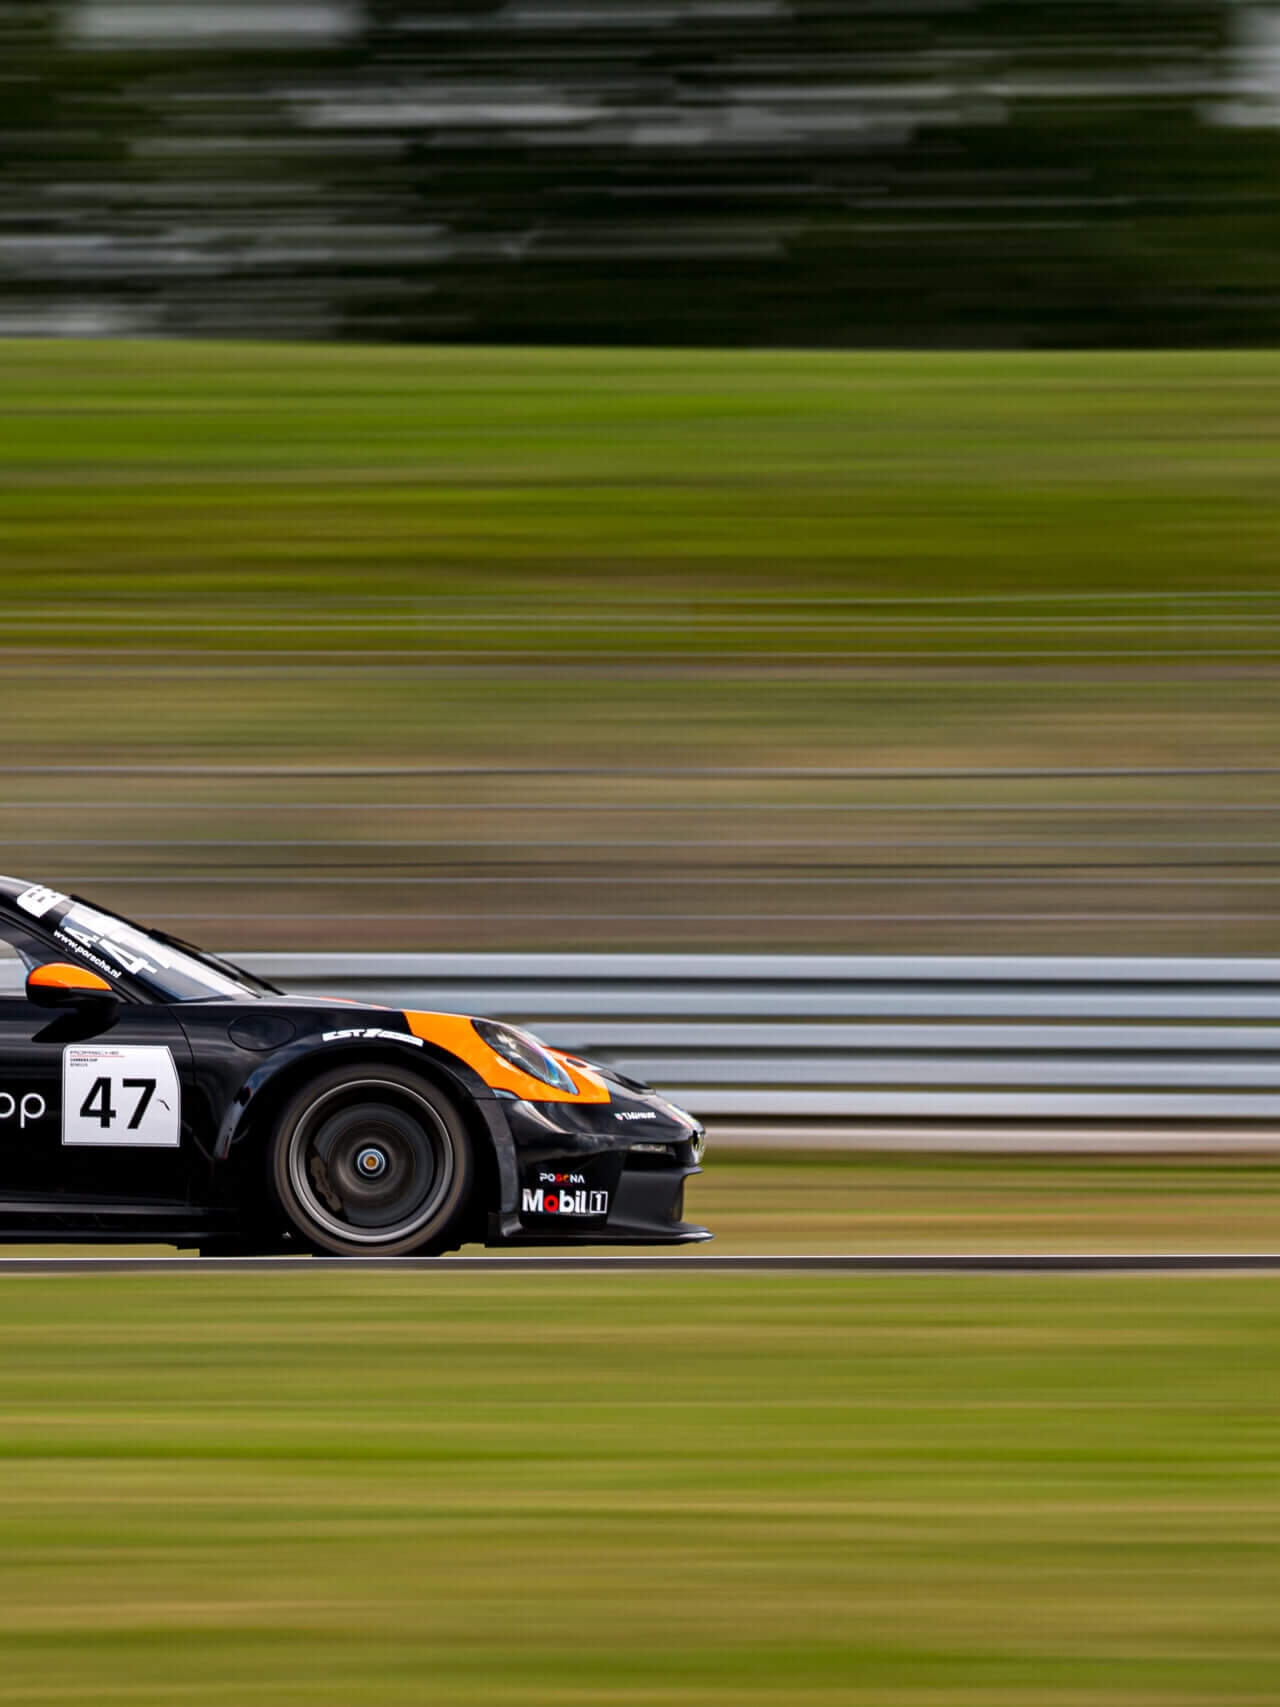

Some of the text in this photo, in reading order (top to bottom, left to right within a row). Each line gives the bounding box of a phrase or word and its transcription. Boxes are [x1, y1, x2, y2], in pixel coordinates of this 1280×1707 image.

[53, 929, 122, 979] www.porsche.nl
[80, 1077, 157, 1130] 47
[522, 1188, 587, 1213] Mobil
